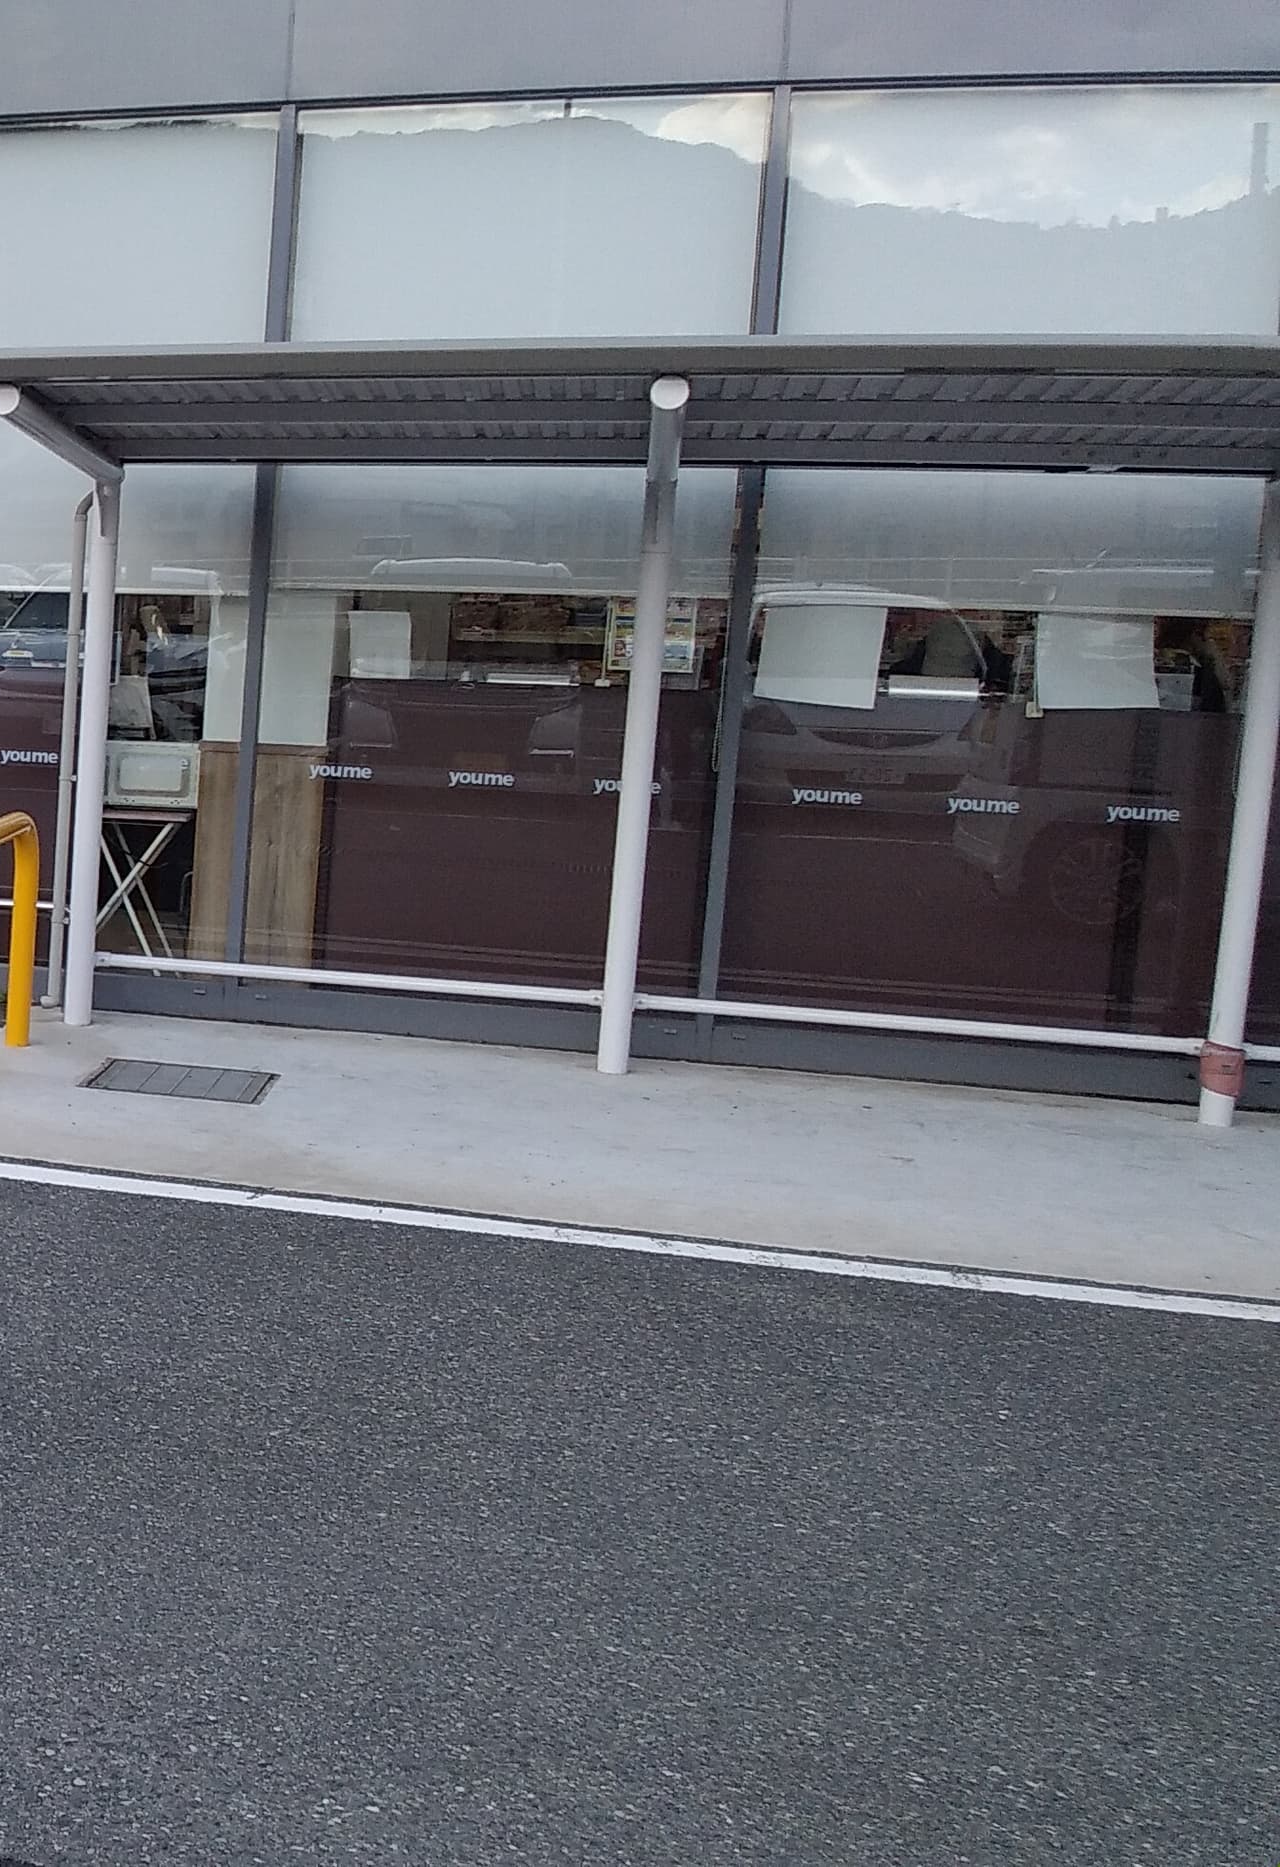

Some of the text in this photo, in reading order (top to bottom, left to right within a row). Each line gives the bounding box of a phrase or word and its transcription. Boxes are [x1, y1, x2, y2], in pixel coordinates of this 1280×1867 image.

[0, 749, 58, 765] youme
[309, 764, 373, 780] youme
[449, 771, 514, 787] youme
[792, 788, 862, 805] youme
[948, 797, 1019, 814] youme
[1107, 806, 1181, 823] youme
